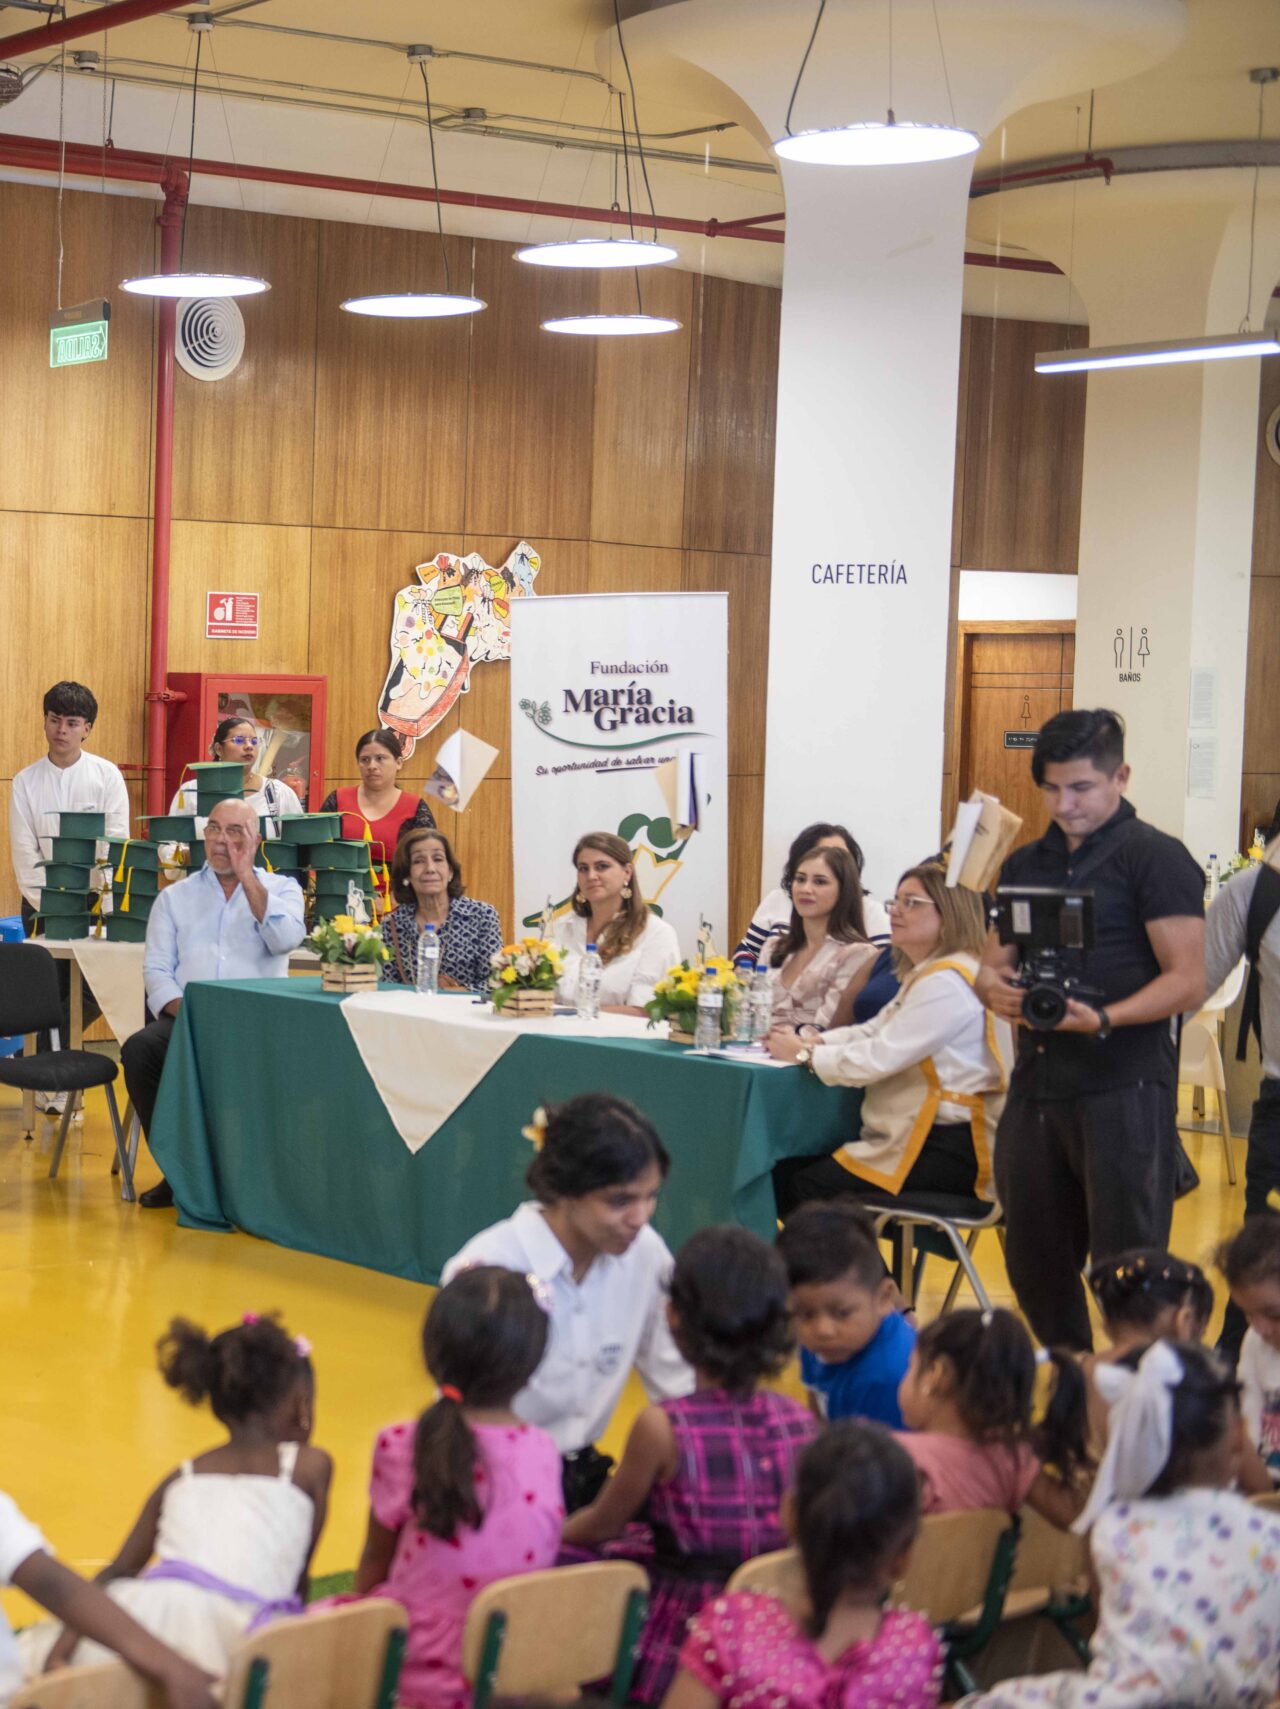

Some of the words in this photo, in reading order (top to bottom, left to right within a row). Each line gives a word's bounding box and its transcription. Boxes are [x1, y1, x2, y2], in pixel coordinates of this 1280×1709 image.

[811, 559, 908, 585] CAFETERÍA
[590, 660, 669, 675] Fundación
[1119, 672, 1141, 682] BAÑOS
[563, 680, 653, 713] María
[594, 699, 695, 731] Gracia
[535, 765, 549, 776] Su
[551, 757, 609, 775] oportunidad
[611, 756, 623, 767] de
[625, 755, 656, 767] salvar
